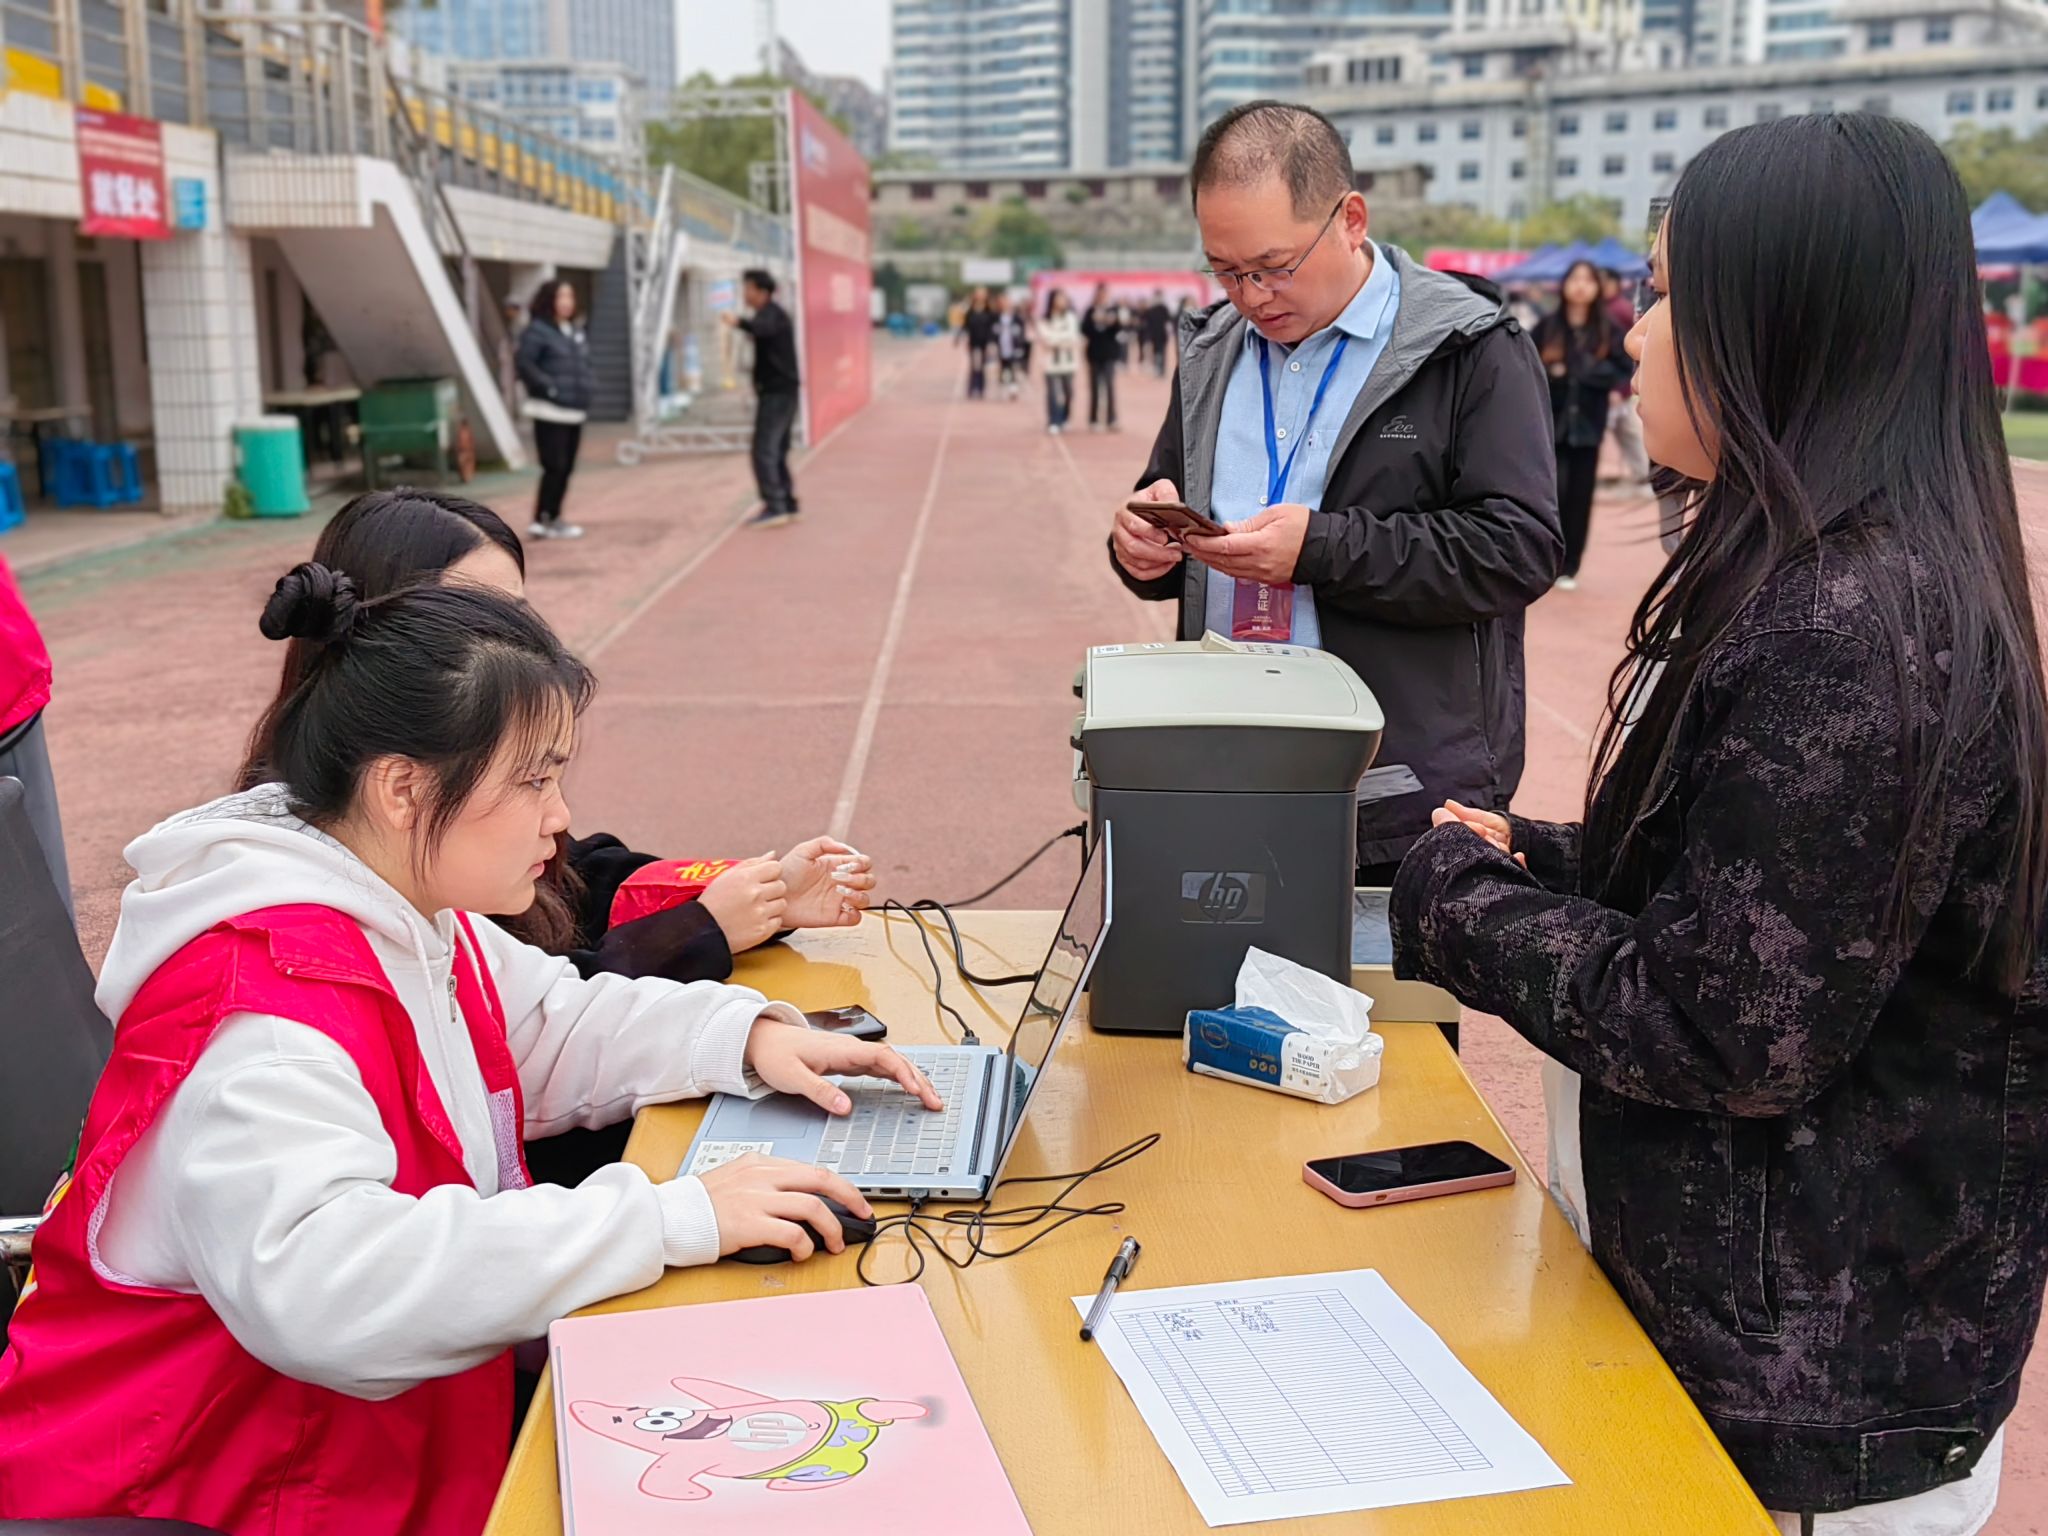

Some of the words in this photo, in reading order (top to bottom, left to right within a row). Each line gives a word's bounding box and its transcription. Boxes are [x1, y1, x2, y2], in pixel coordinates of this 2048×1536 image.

[1203, 871, 1244, 923] hp
[1297, 1052, 1315, 1061] WOOD
[728, 1417, 808, 1445] hp
